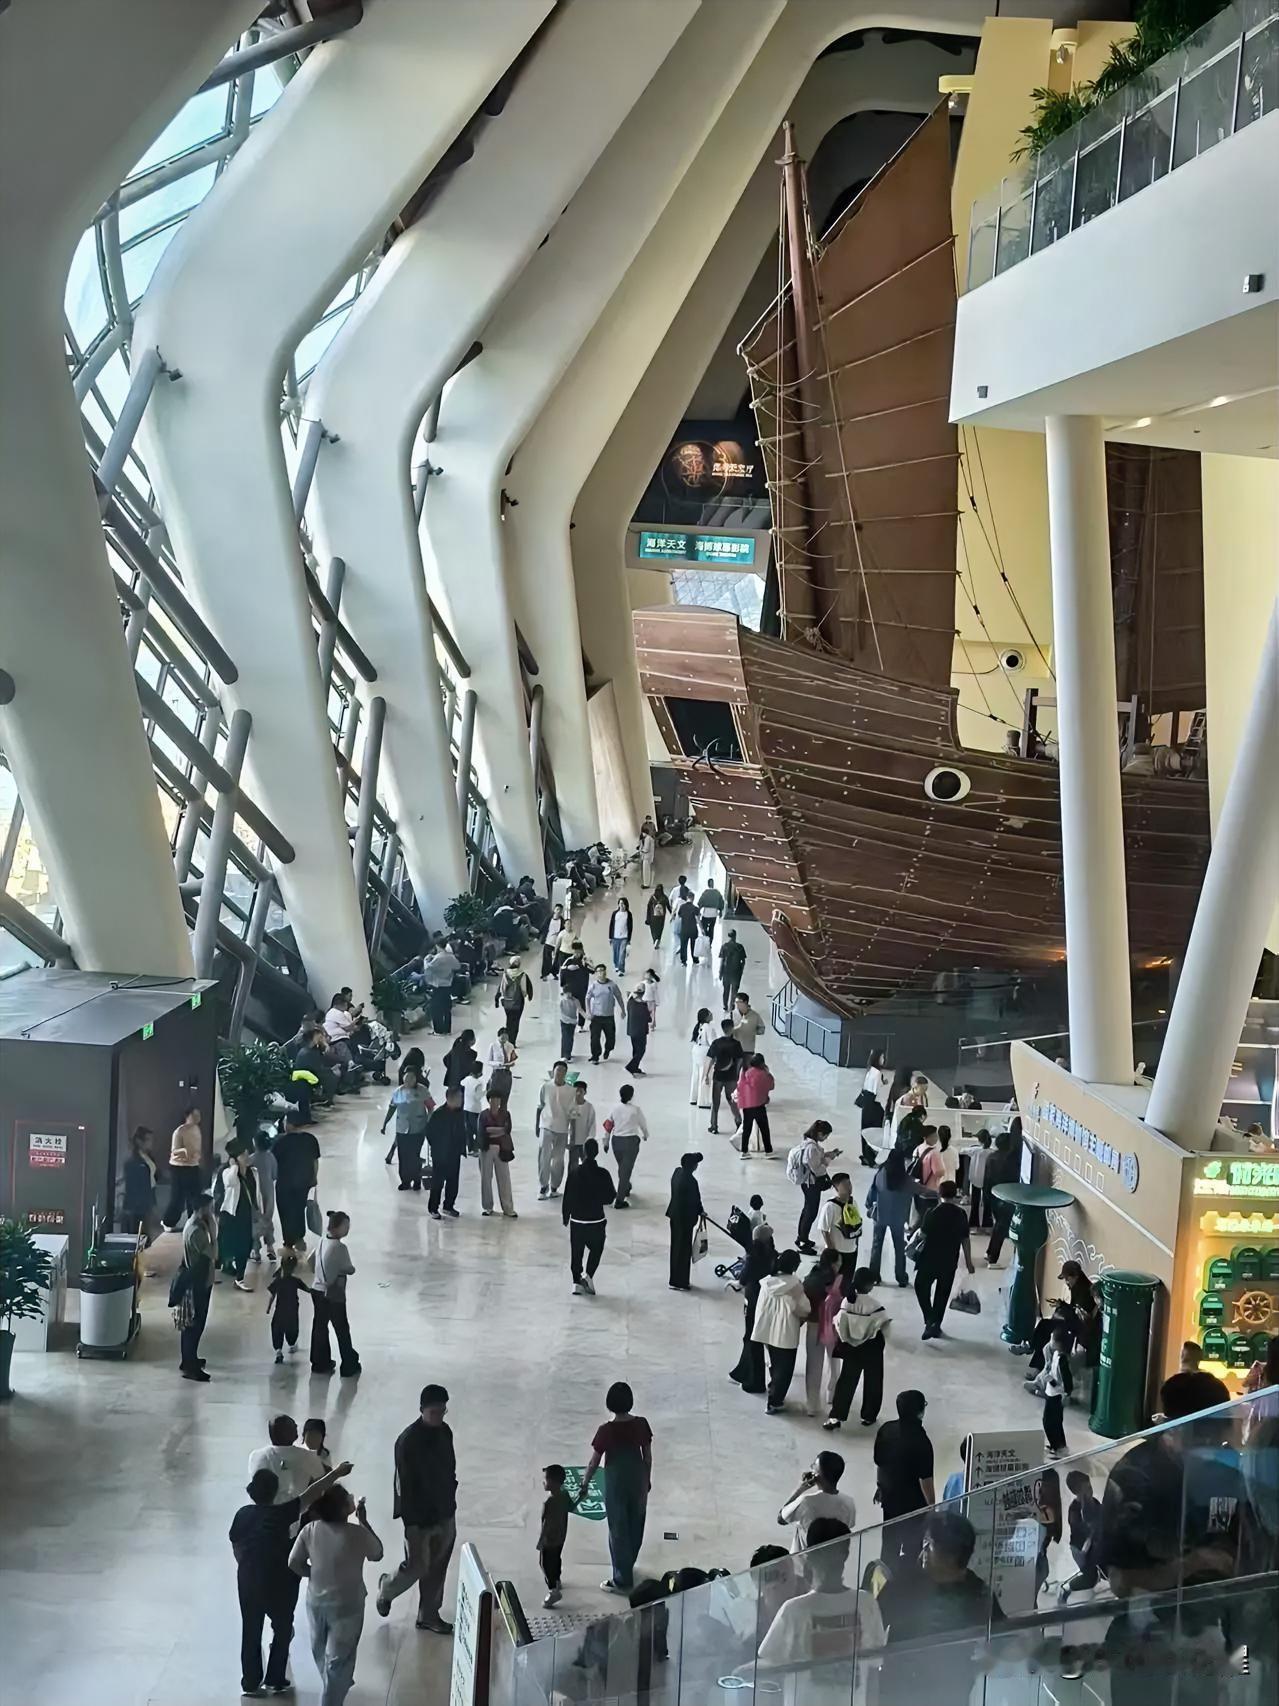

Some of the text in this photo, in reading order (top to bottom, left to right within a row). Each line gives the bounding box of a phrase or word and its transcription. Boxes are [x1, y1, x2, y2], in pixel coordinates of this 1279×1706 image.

[646, 538, 687, 549] 海洋天文
[35, 1137, 62, 1145] 消火栓
